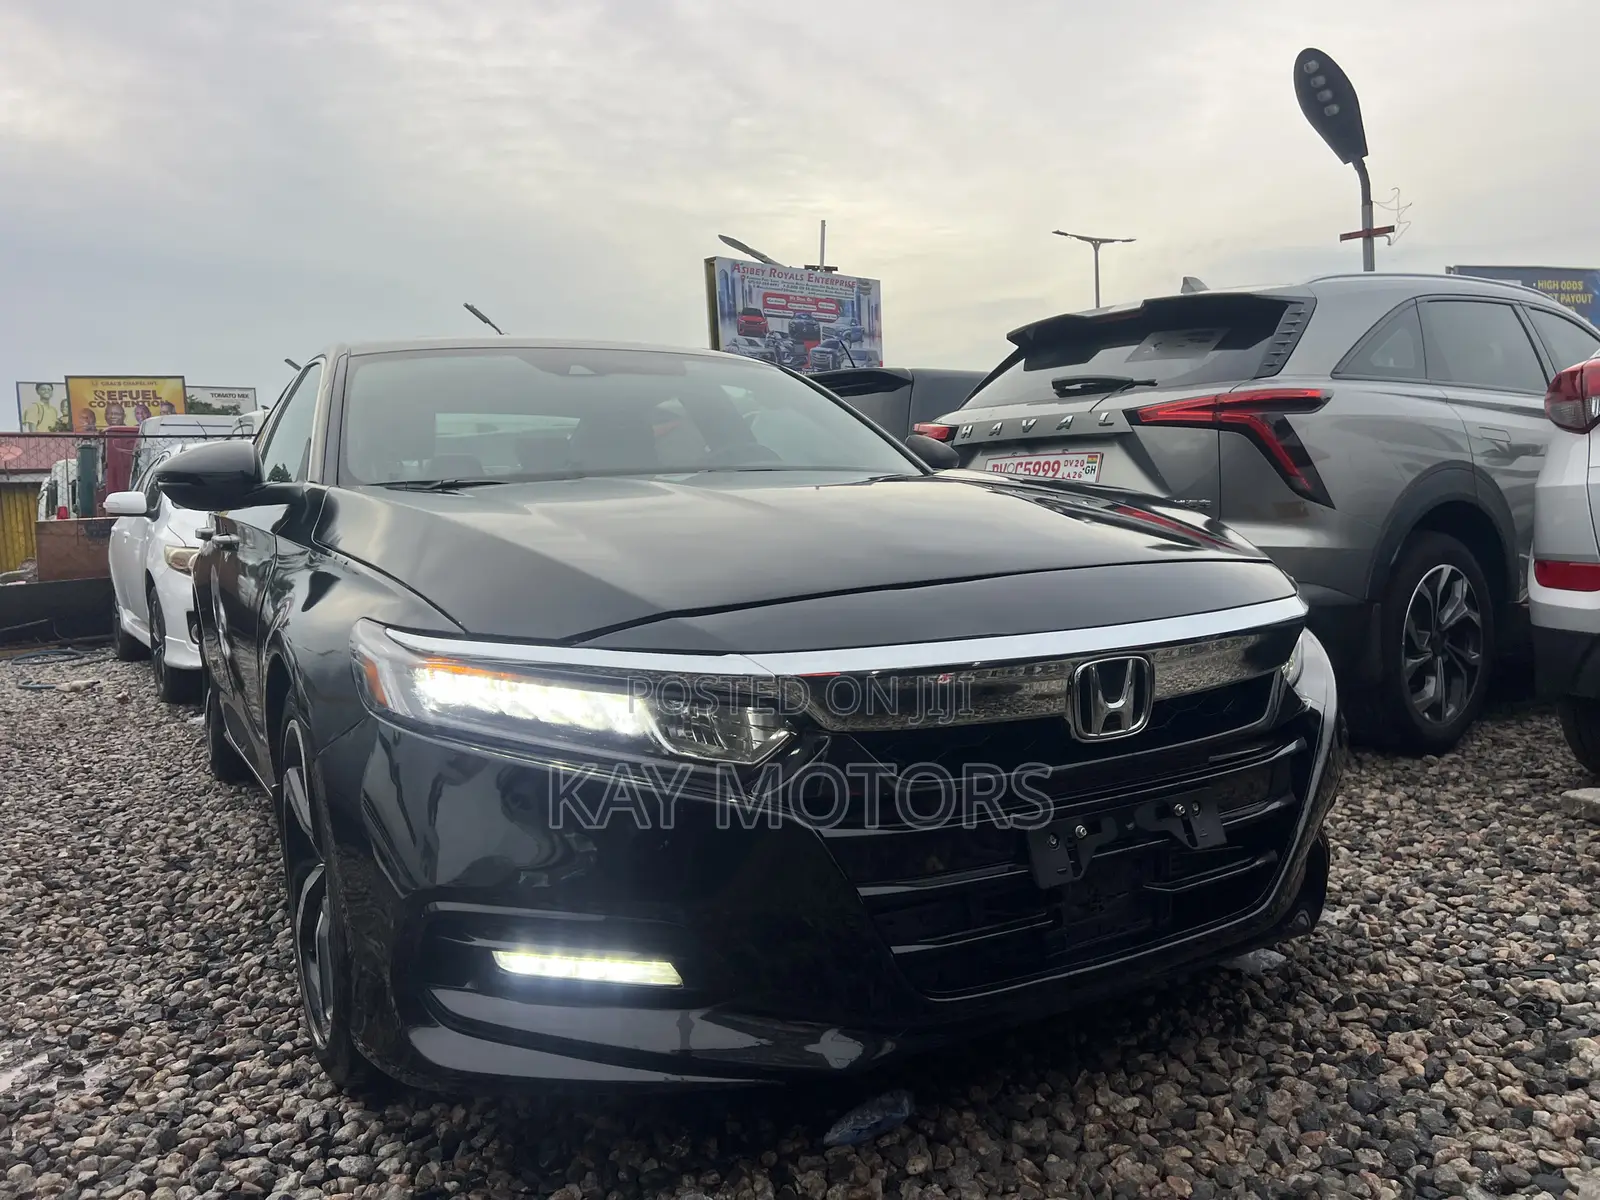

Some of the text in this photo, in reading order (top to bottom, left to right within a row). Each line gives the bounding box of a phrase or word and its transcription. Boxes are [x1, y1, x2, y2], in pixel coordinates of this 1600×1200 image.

[732, 263, 766, 275] ASIBEY
[769, 268, 804, 281] ROYALS
[807, 273, 857, 288] ENTERPRISE
[1537, 280, 1583, 290] HIGH ODDS
[1560, 293, 1593, 304] PAYOUT
[960, 411, 1115, 439] HAVAL
[1063, 459, 1085, 468] DV20
[1084, 465, 1097, 475] GH
